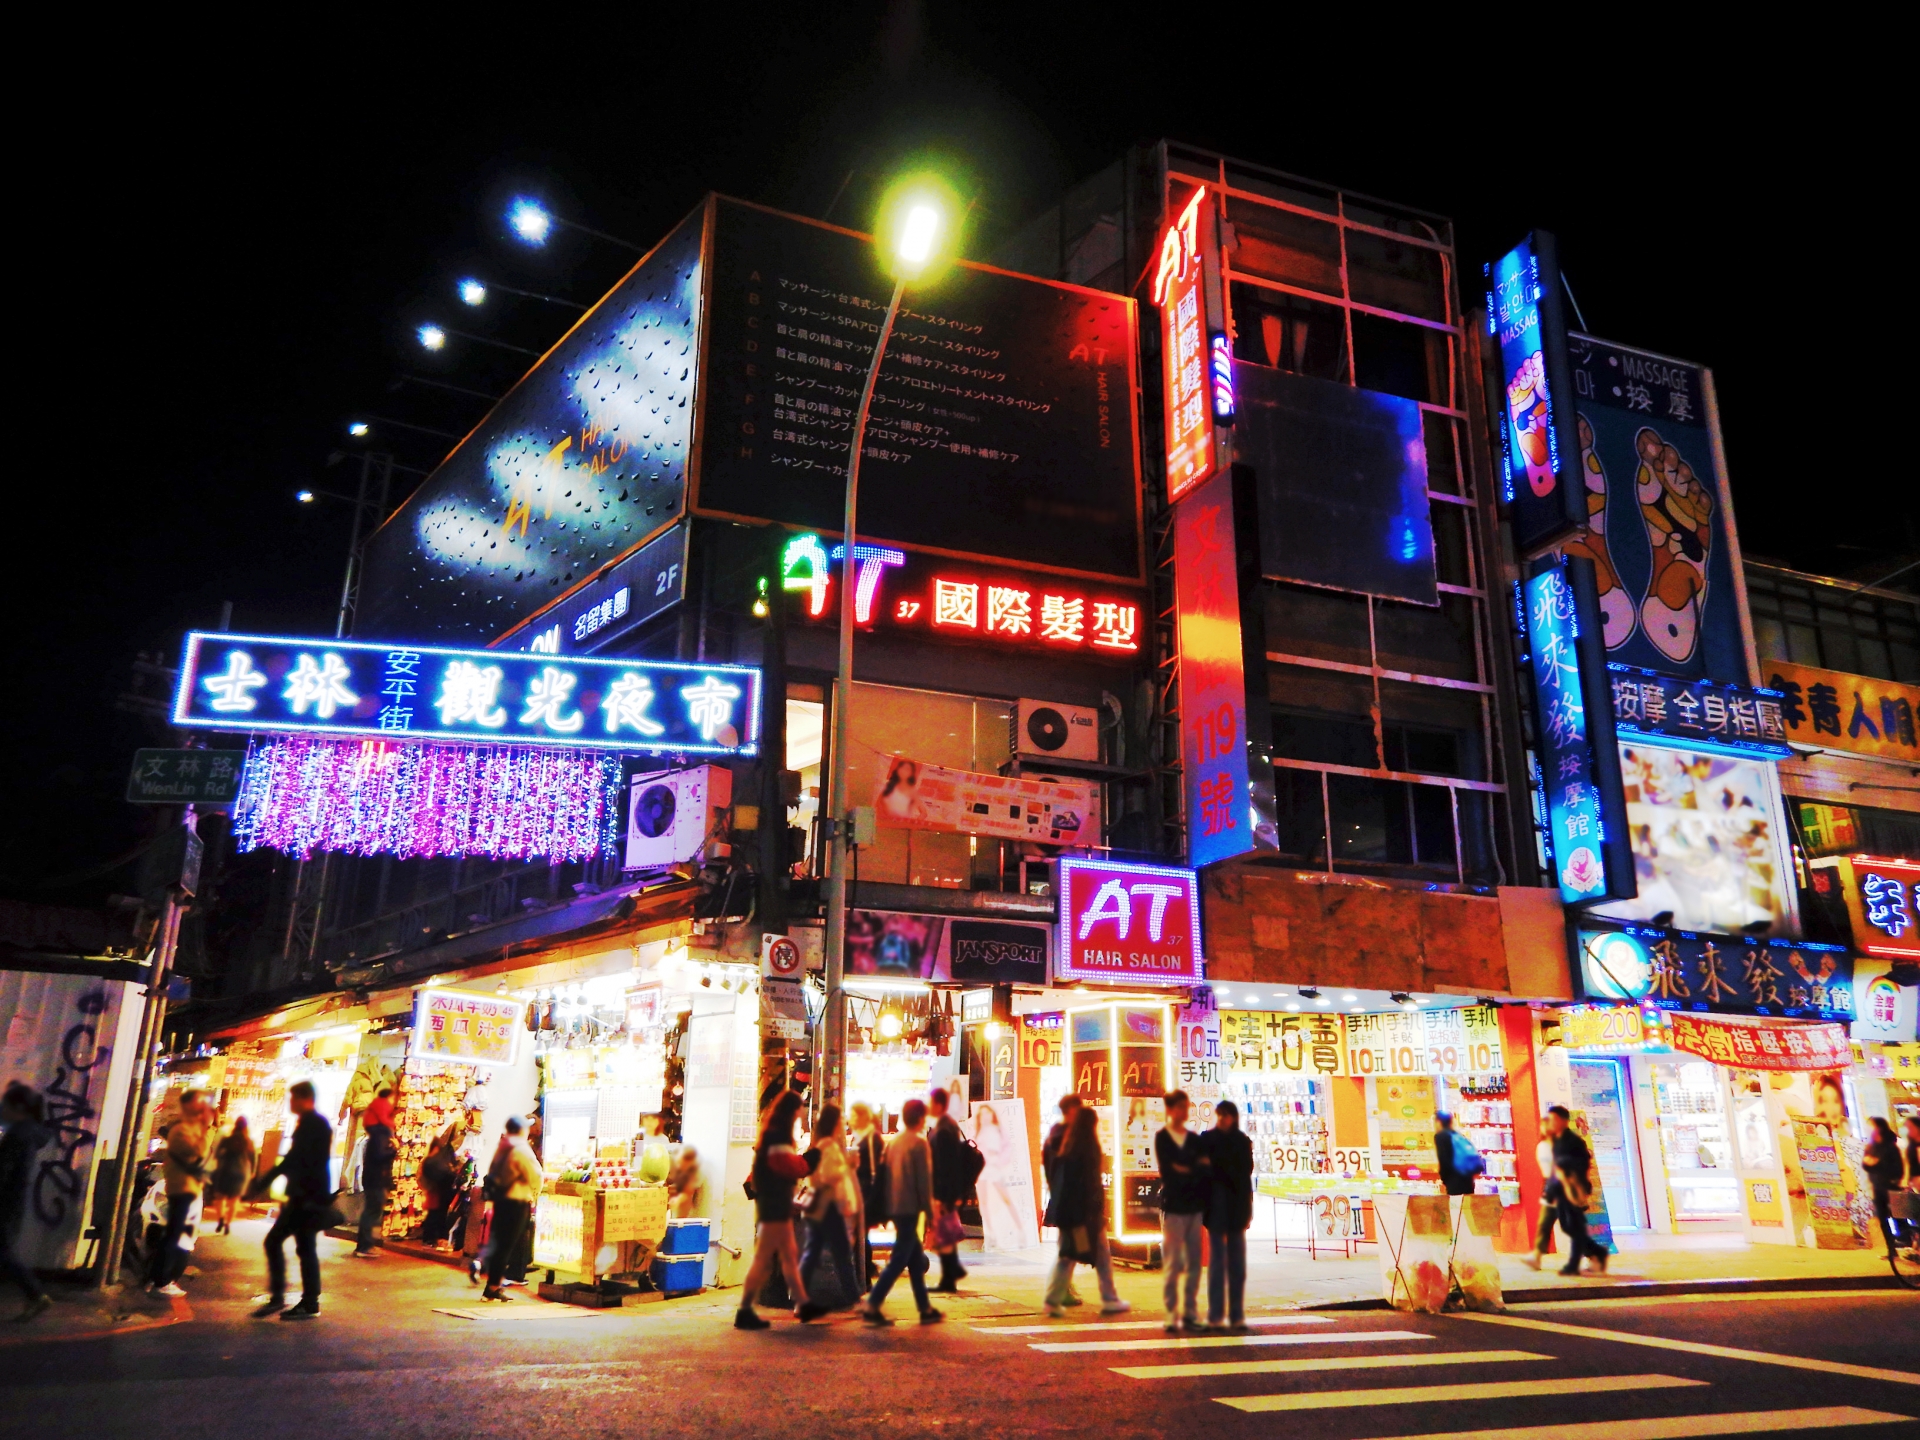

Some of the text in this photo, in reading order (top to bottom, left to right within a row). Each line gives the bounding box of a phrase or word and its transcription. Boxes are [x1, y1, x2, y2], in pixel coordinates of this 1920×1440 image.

[1154, 185, 1206, 304] AT
[749, 270, 762, 283] A
[1497, 266, 1532, 295] マッサー
[748, 293, 761, 306] B
[778, 277, 984, 335] マッサージ+台湾式シャプー+スタイリング
[747, 316, 759, 329] C
[1501, 309, 1538, 347] MASSAG
[747, 340, 758, 352] D
[776, 323, 1007, 383] 首と肩の精油マッサジ+補修ケア+スタイリング
[1069, 343, 1109, 366] AT
[745, 364, 757, 377] E
[1177, 284, 1204, 437] 國際髮型
[1621, 355, 1689, 393] MASSAGE
[744, 394, 755, 405] F
[1096, 371, 1111, 449] HAIR SALON
[1625, 380, 1694, 423] 按摩
[742, 421, 755, 435] G
[577, 429, 637, 489] SALON
[740, 447, 753, 459] H
[772, 428, 912, 464] 台湾式シャンプ+頭皮ケア
[770, 453, 849, 477] シャンプー+カッ
[781, 534, 920, 623] AT 37
[573, 563, 679, 641] 名留集團 2F
[932, 579, 1138, 650] 國際髮型
[521, 623, 559, 653] ON
[204, 651, 739, 740] 士林 觀光夜市
[379, 649, 420, 733] 安平街
[144, 755, 233, 779] 文林路
[141, 780, 227, 796] WenLin Rd
[1079, 878, 1184, 946] AT 37
[955, 939, 1043, 965] JANSPORT
[1083, 949, 1182, 970] HAIR SALON
[1647, 940, 1851, 1012] 飛來發 按摩館
[502, 1006, 514, 1016] 45
[1347, 1013, 1383, 1033] 手机
[1386, 1012, 1422, 1031] 手机
[1425, 1009, 1461, 1029] 手机
[1463, 1007, 1497, 1028] 手机
[1599, 1010, 1639, 1039] 200
[430, 1014, 510, 1037] 西瓜汁 35
[1023, 1038, 1063, 1067] 10元
[1180, 1025, 1220, 1059] 10元
[994, 1043, 1013, 1087] AT
[1350, 1047, 1387, 1075] 10元
[1389, 1045, 1427, 1074] 10元
[1468, 1042, 1503, 1071] 10元
[1077, 1061, 1108, 1094] AT
[1123, 1061, 1158, 1085] AT
[1180, 1061, 1221, 1085] 手机
[1001, 1105, 1018, 1117] AT
[1272, 1146, 1310, 1172] 39元
[1334, 1149, 1372, 1173] 39元
[1101, 1172, 1113, 1186] 2F
[1137, 1185, 1152, 1196] 2F
[1314, 1193, 1365, 1237] 39元
